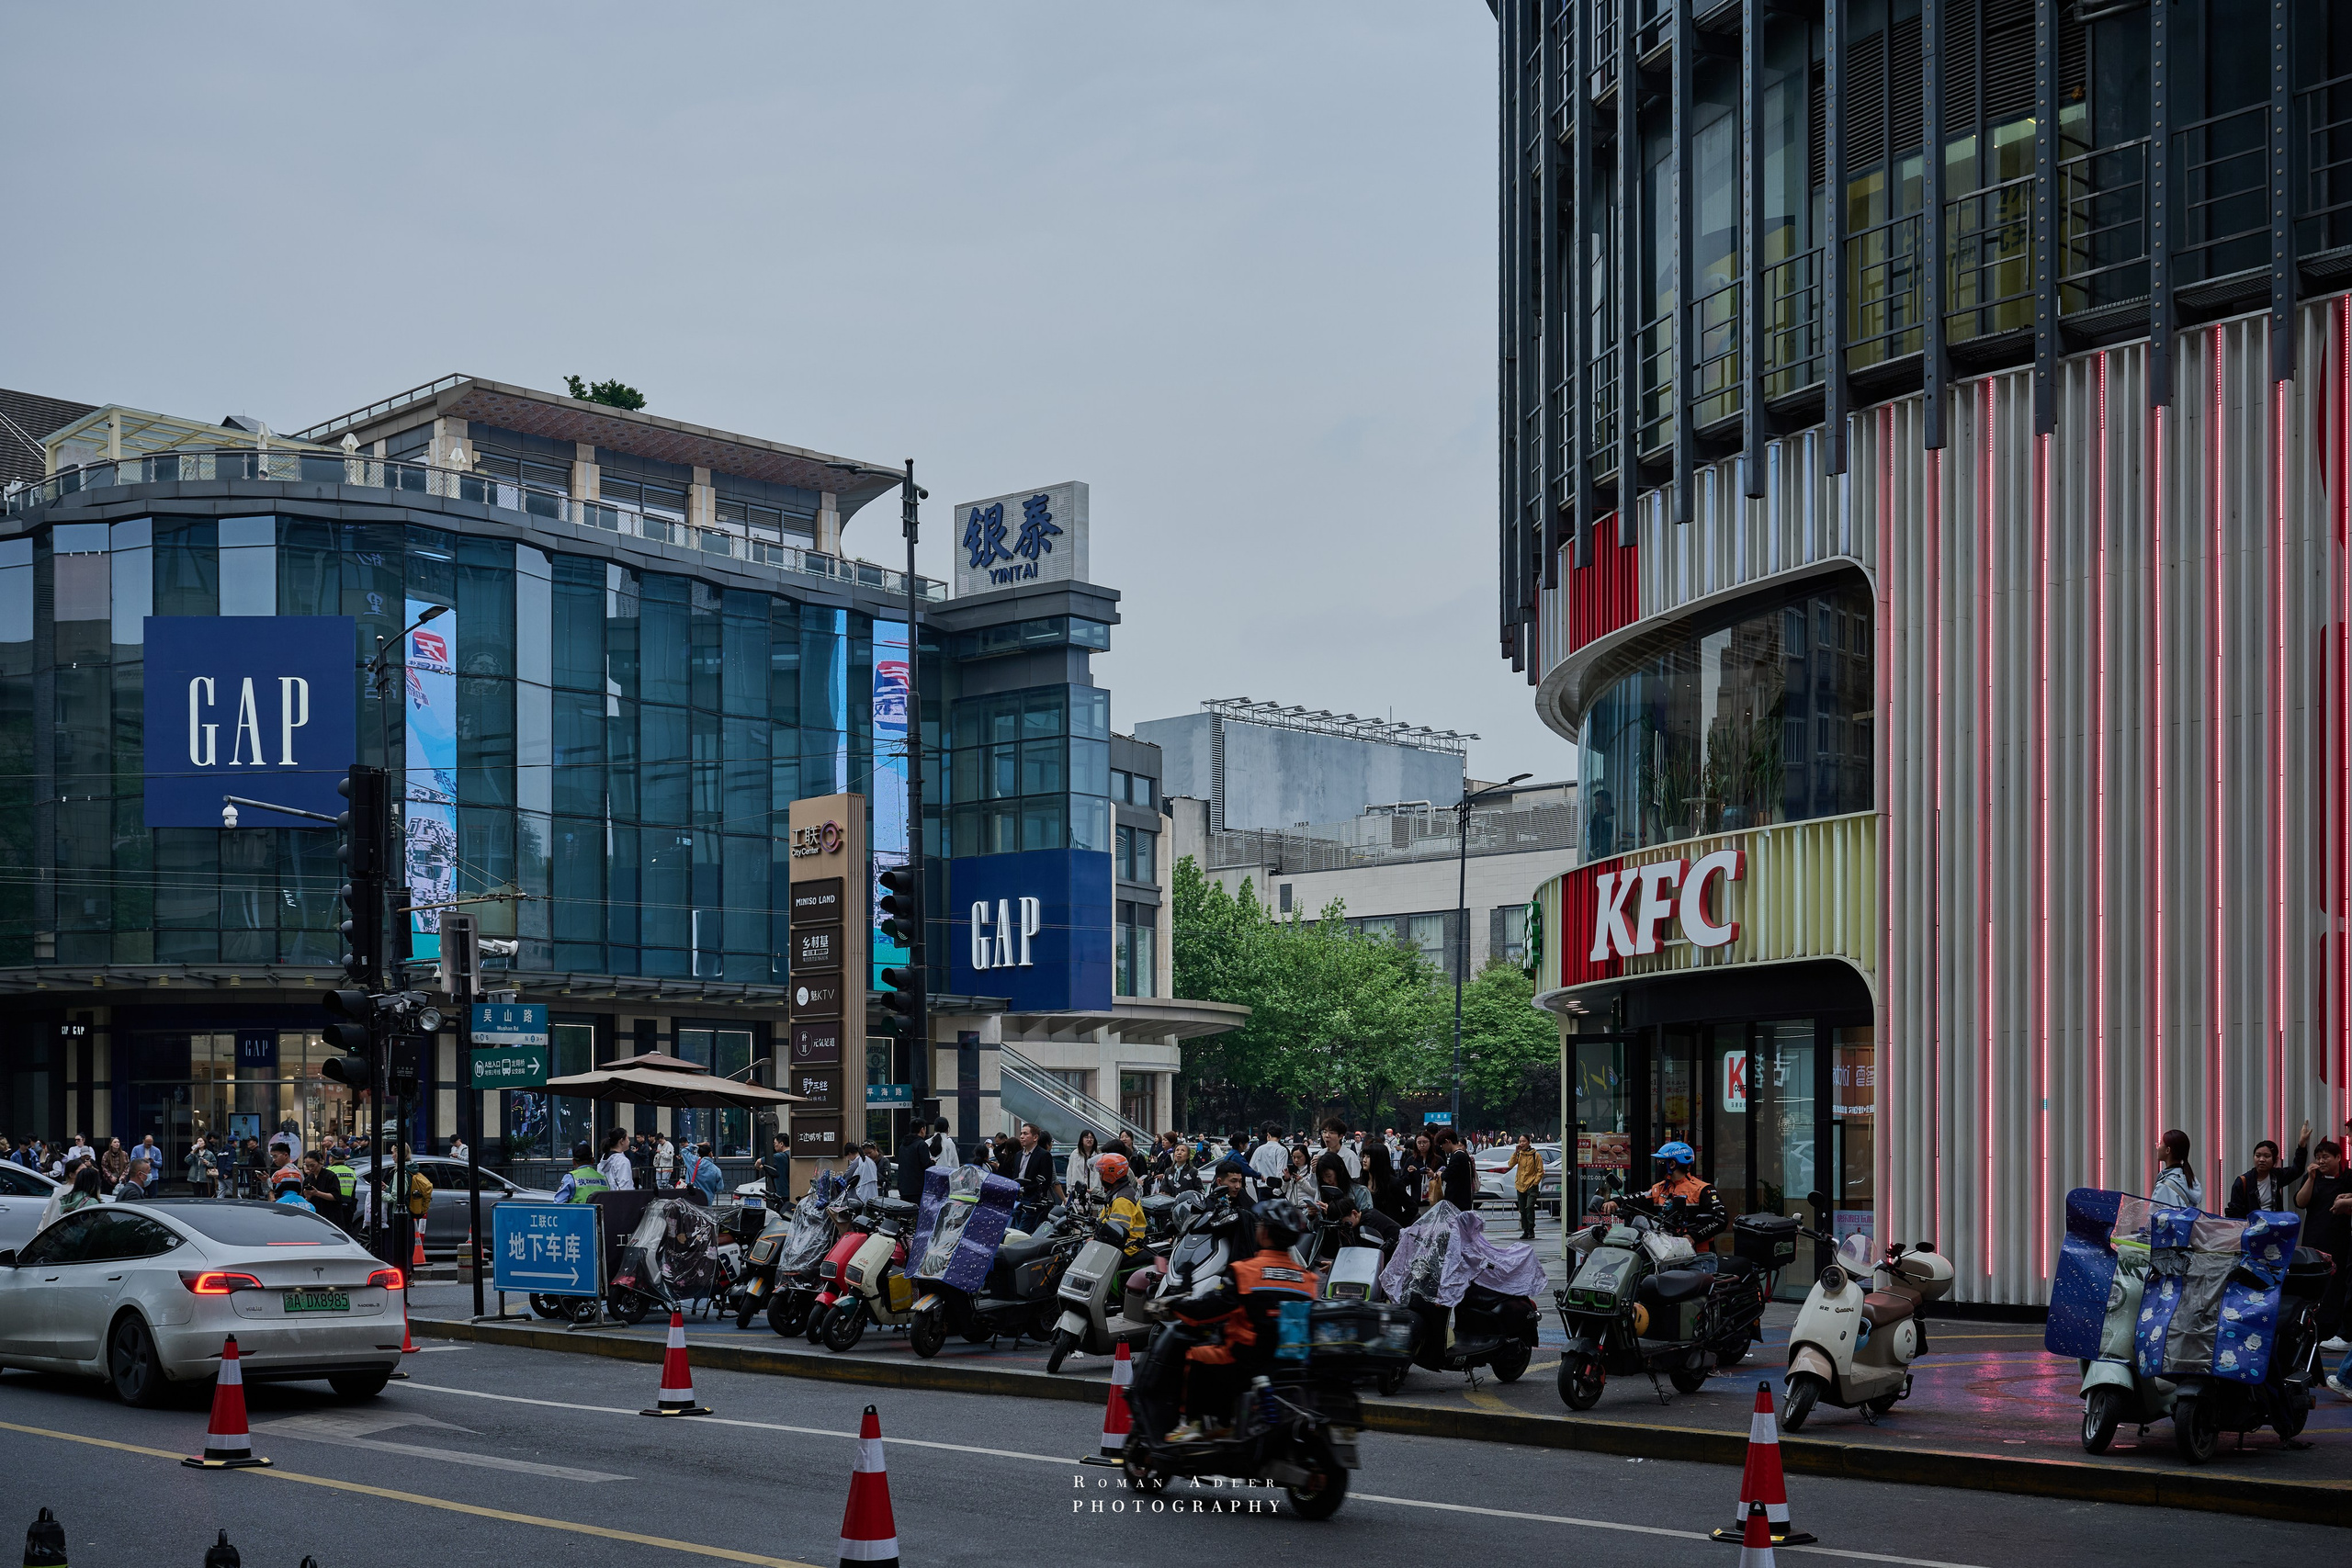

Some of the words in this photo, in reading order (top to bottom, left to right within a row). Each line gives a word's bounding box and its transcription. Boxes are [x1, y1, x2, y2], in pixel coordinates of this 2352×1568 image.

[962, 493, 1064, 569] 银泰
[989, 561, 1039, 585] YINTAI
[188, 676, 309, 767] GAP
[791, 826, 820, 848] 工联
[819, 894, 835, 905] LAND
[1589, 849, 1746, 964] KFC
[971, 896, 1041, 971] GAP
[482, 1008, 533, 1023] 吴山路
[72, 1025, 85, 1035] GAP
[244, 1039, 268, 1057] GAP
[529, 1213, 559, 1229] 工联CC
[508, 1231, 581, 1264] 地下车库
[306, 1292, 348, 1308] DX8985
